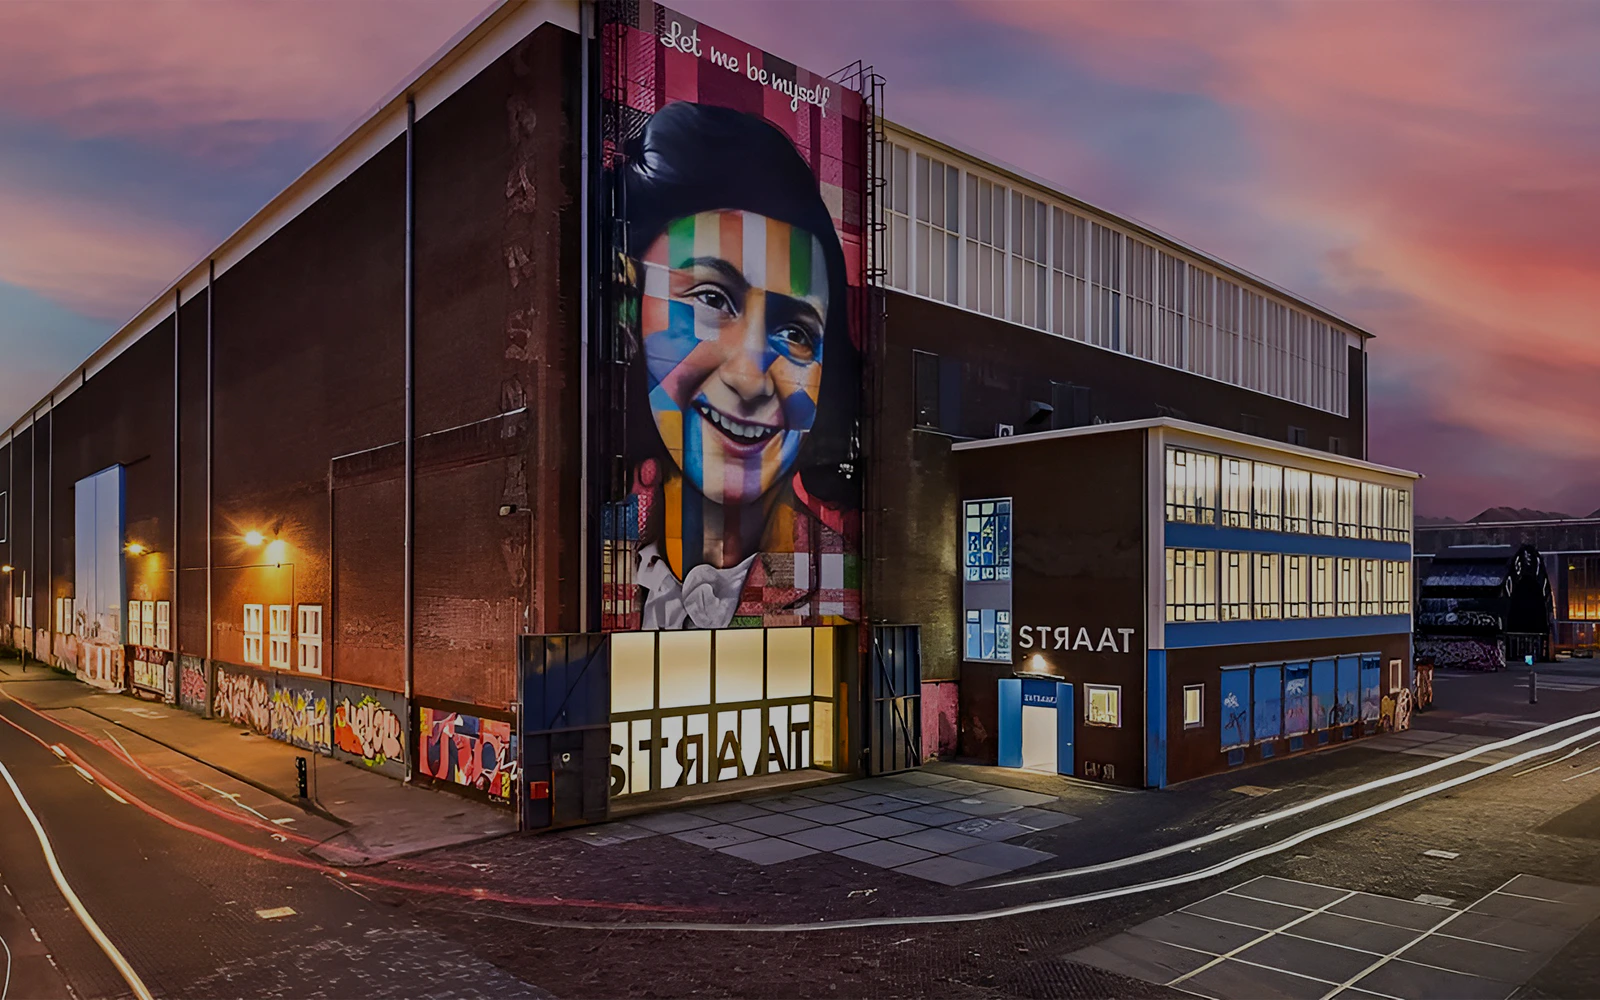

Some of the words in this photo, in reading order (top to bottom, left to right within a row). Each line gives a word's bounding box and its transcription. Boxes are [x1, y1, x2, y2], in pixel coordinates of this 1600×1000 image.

[660, 21, 702, 57] Let
[710, 45, 740, 73] me
[746, 52, 769, 86] be
[771, 72, 831, 118] myself
[1018, 625, 1135, 654] STRAAT
